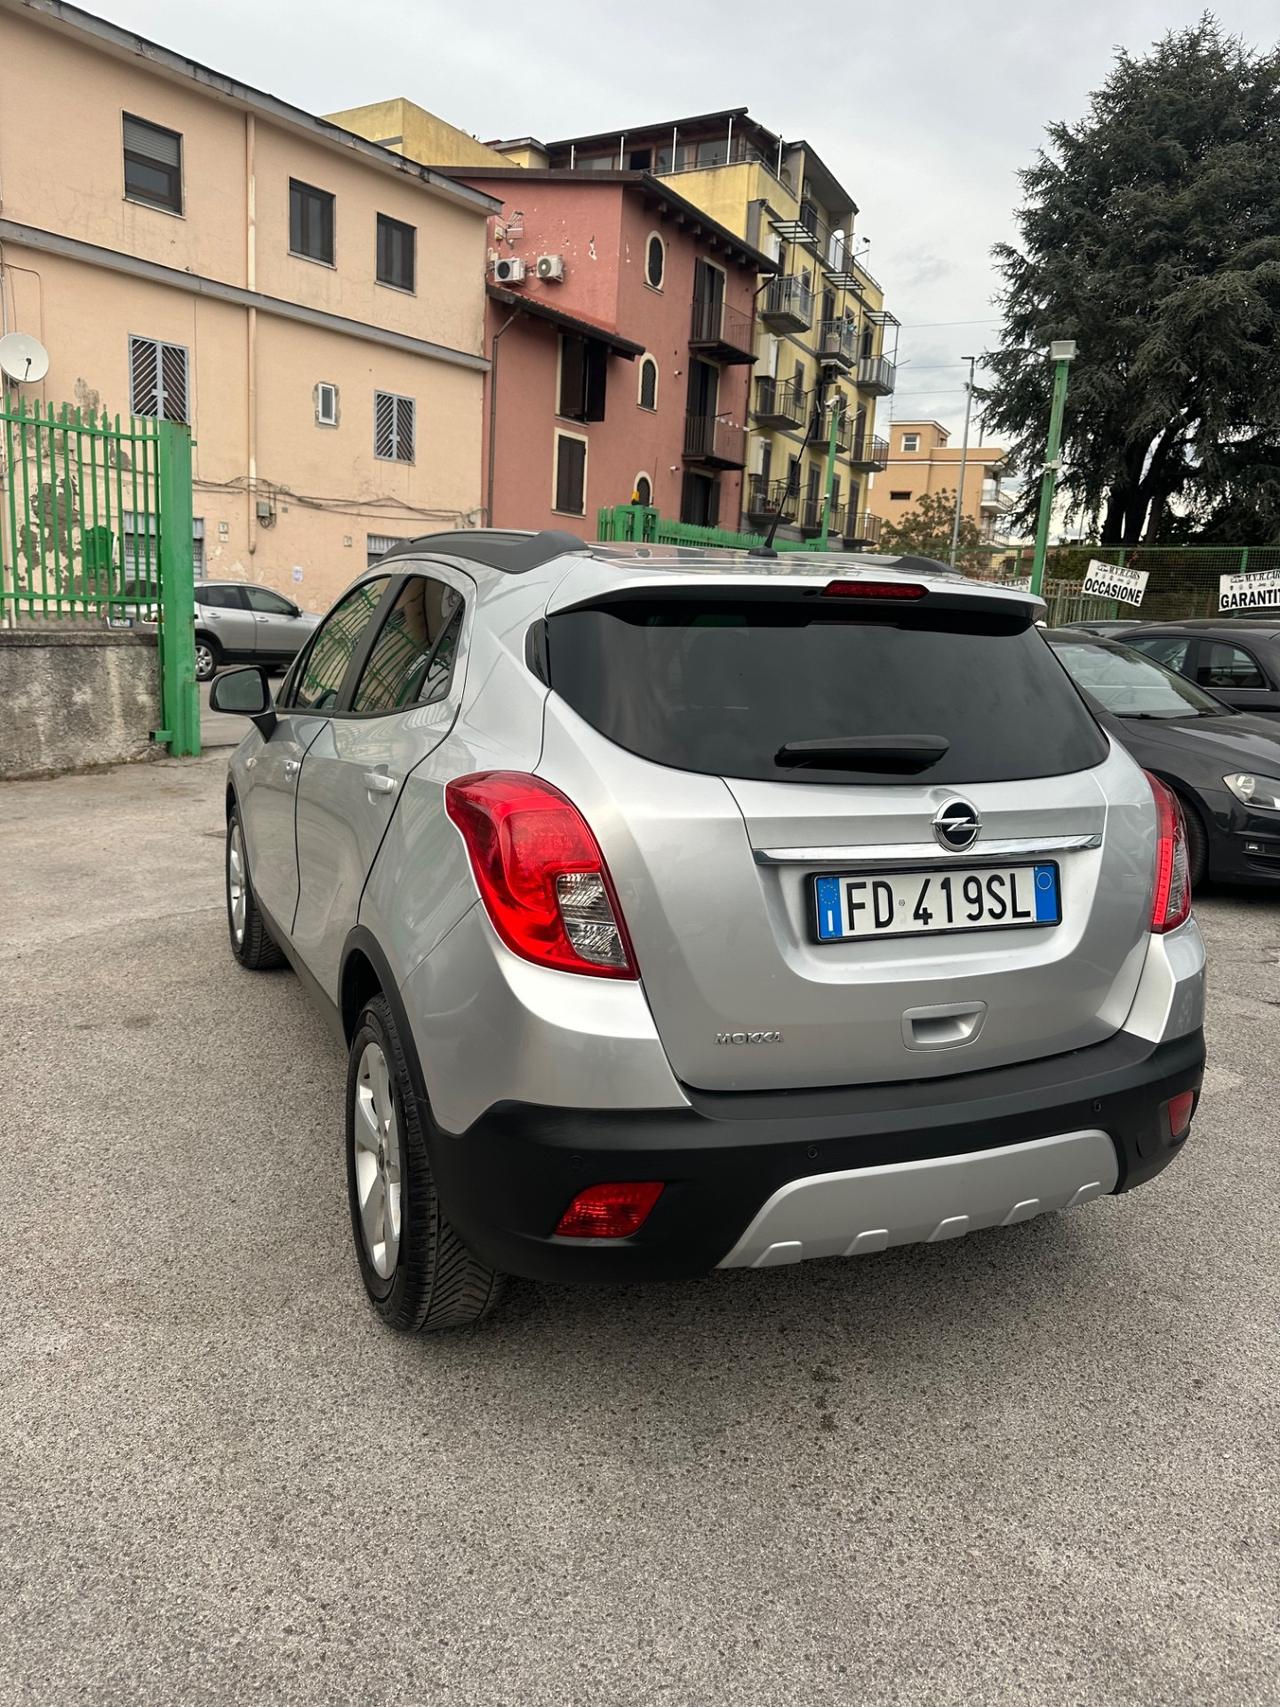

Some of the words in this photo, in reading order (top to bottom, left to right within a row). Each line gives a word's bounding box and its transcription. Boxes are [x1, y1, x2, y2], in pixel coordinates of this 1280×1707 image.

[1085, 578, 1142, 604] OCCASIONE
[846, 880, 894, 931] FD
[913, 873, 1031, 925] 419SL
[714, 1031, 781, 1045] MOKKA
